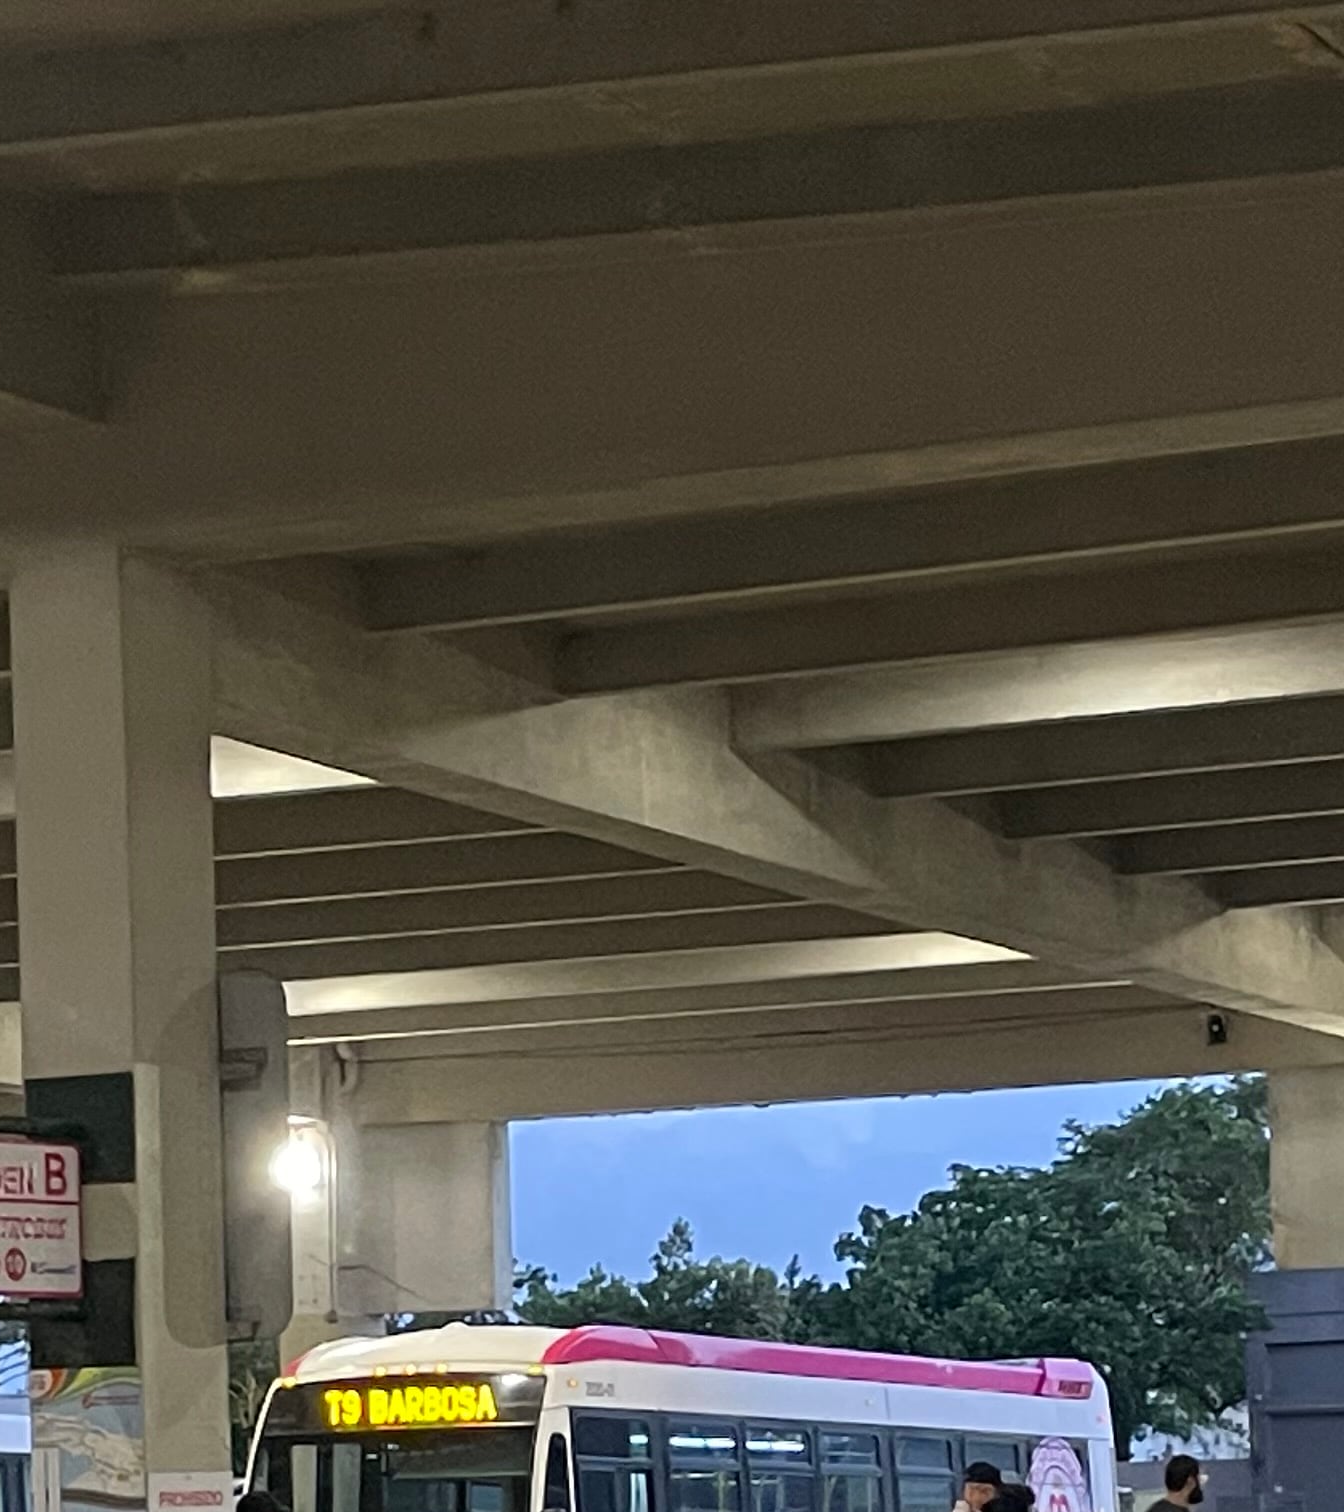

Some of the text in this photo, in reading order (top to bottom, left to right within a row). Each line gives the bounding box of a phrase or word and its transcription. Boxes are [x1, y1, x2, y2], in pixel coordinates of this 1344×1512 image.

[44, 1152, 67, 1196] B
[325, 1384, 498, 1426] T9 BARBOSA
